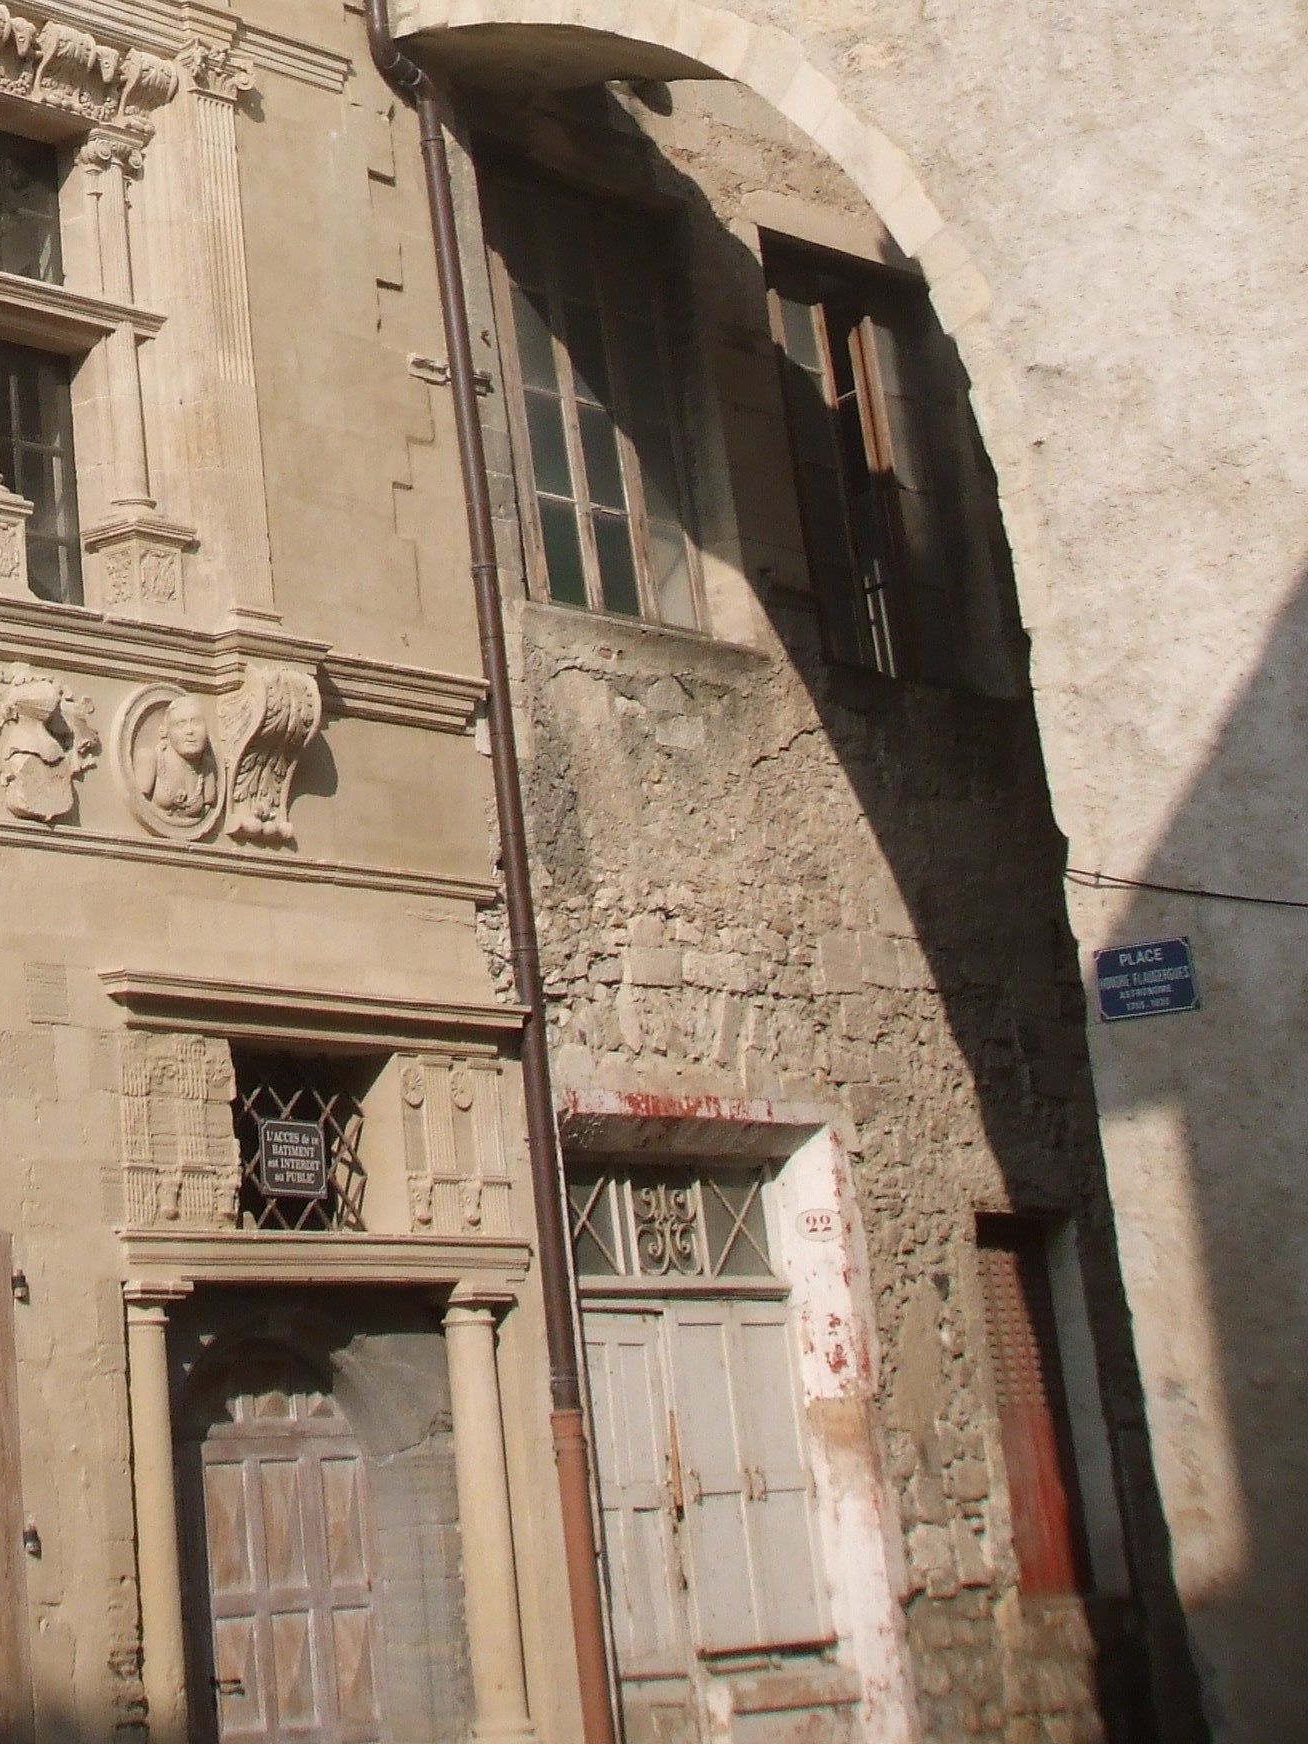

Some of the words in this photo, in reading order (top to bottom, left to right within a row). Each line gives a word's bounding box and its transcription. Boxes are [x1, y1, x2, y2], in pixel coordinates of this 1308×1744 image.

[1119, 947, 1164, 966] PLACE
[272, 1144, 315, 1158] BATIMENT
[280, 1158, 320, 1171] INTERDIT
[286, 1172, 315, 1184] PUBLIC
[805, 1215, 832, 1233] 22
